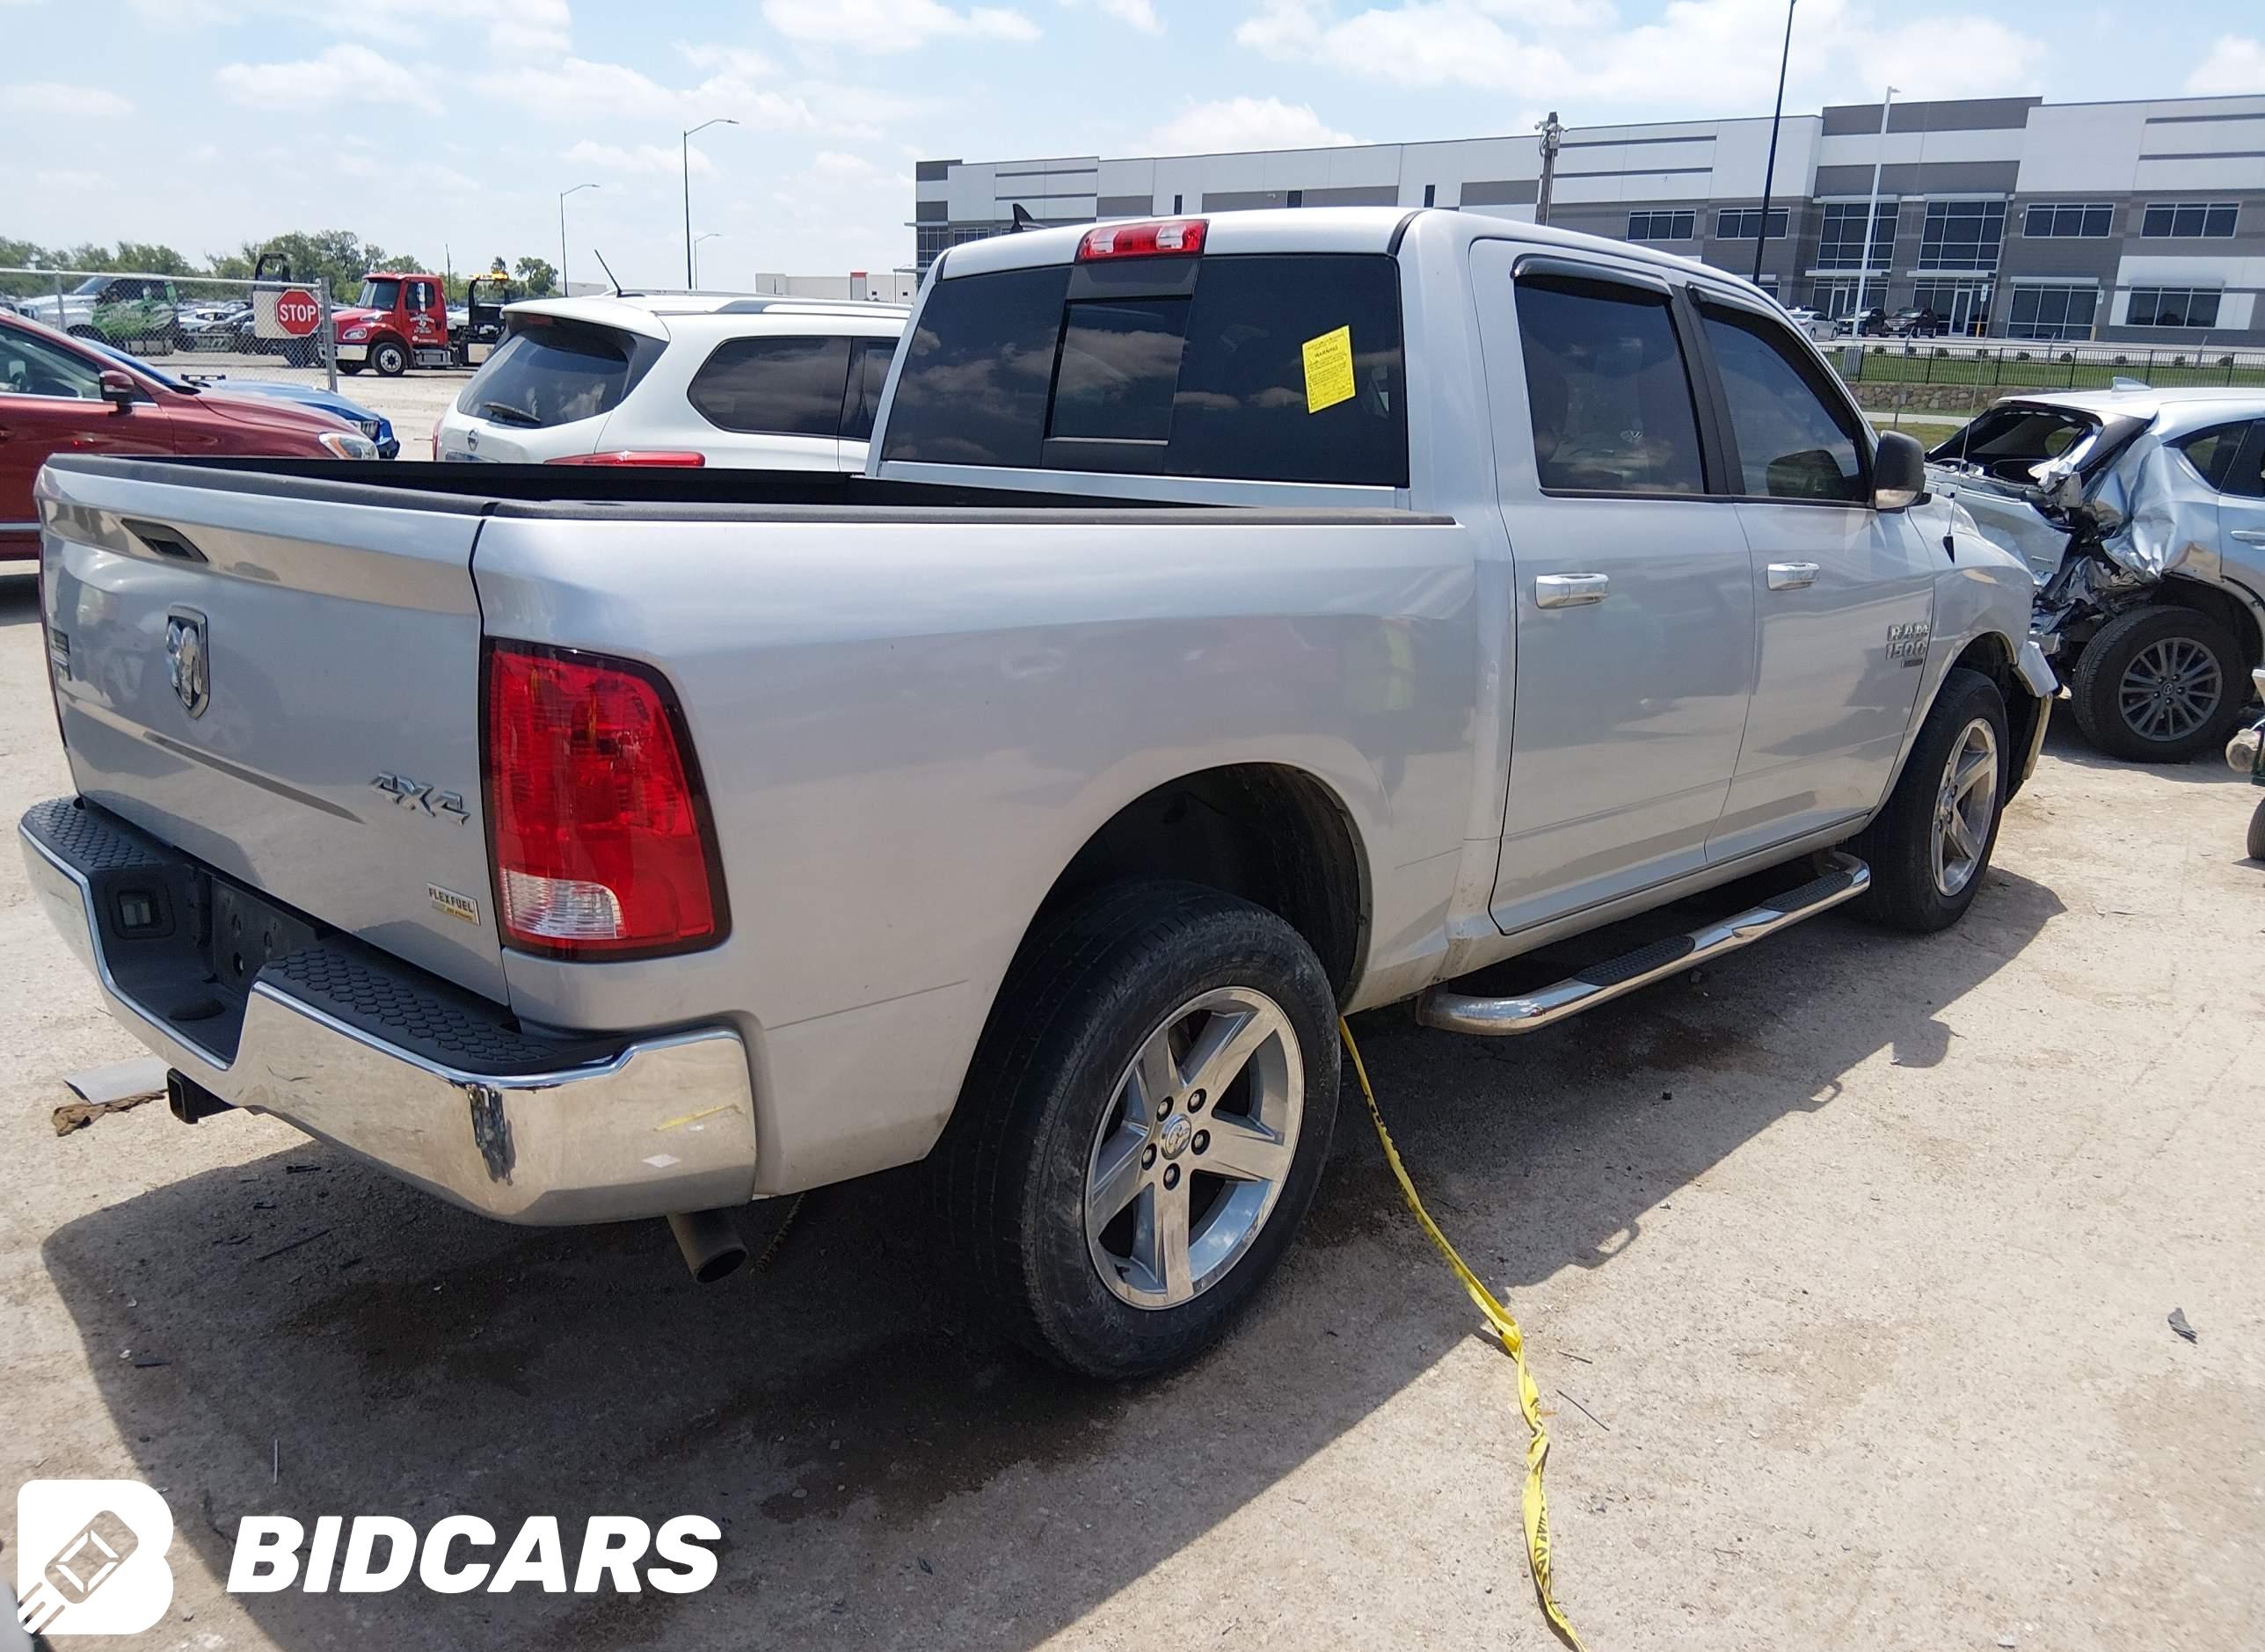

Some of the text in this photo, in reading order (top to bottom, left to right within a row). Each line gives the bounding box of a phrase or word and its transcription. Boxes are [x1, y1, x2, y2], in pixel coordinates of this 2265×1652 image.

[279, 303, 317, 323] STOP
[1888, 623, 1929, 641] RAM
[1885, 640, 1926, 660] 1500
